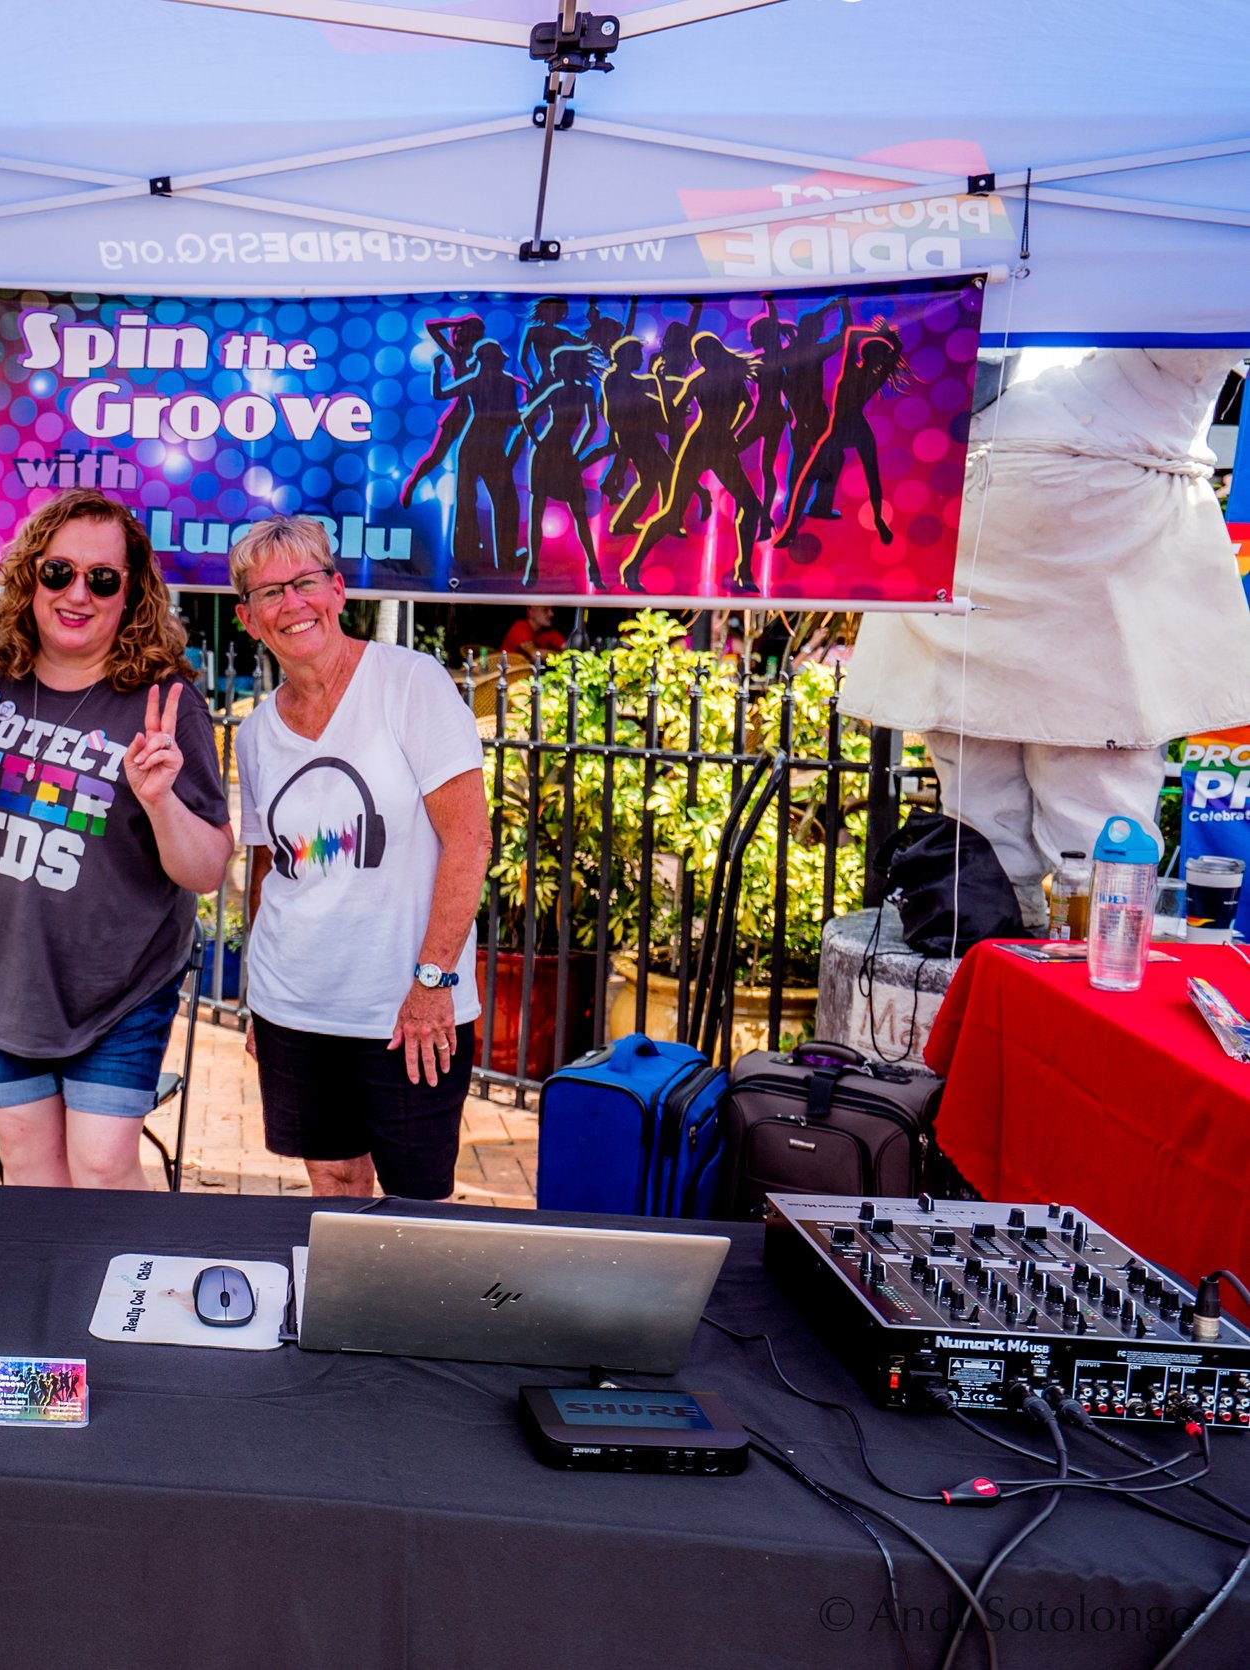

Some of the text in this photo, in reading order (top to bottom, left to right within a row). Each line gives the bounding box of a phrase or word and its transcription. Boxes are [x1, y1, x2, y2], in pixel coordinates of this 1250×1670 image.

[20, 309, 316, 378] Spin the
[70, 380, 372, 442] Groove
[16, 453, 138, 490] with
[136, 1261, 154, 1281] Chick
[130, 1290, 146, 1306] Cool
[122, 1307, 146, 1333] Really
[935, 1335, 1050, 1354] Numark M6 USB
[564, 1402, 701, 1418] SHURE
[572, 1447, 601, 1455] SHURE
